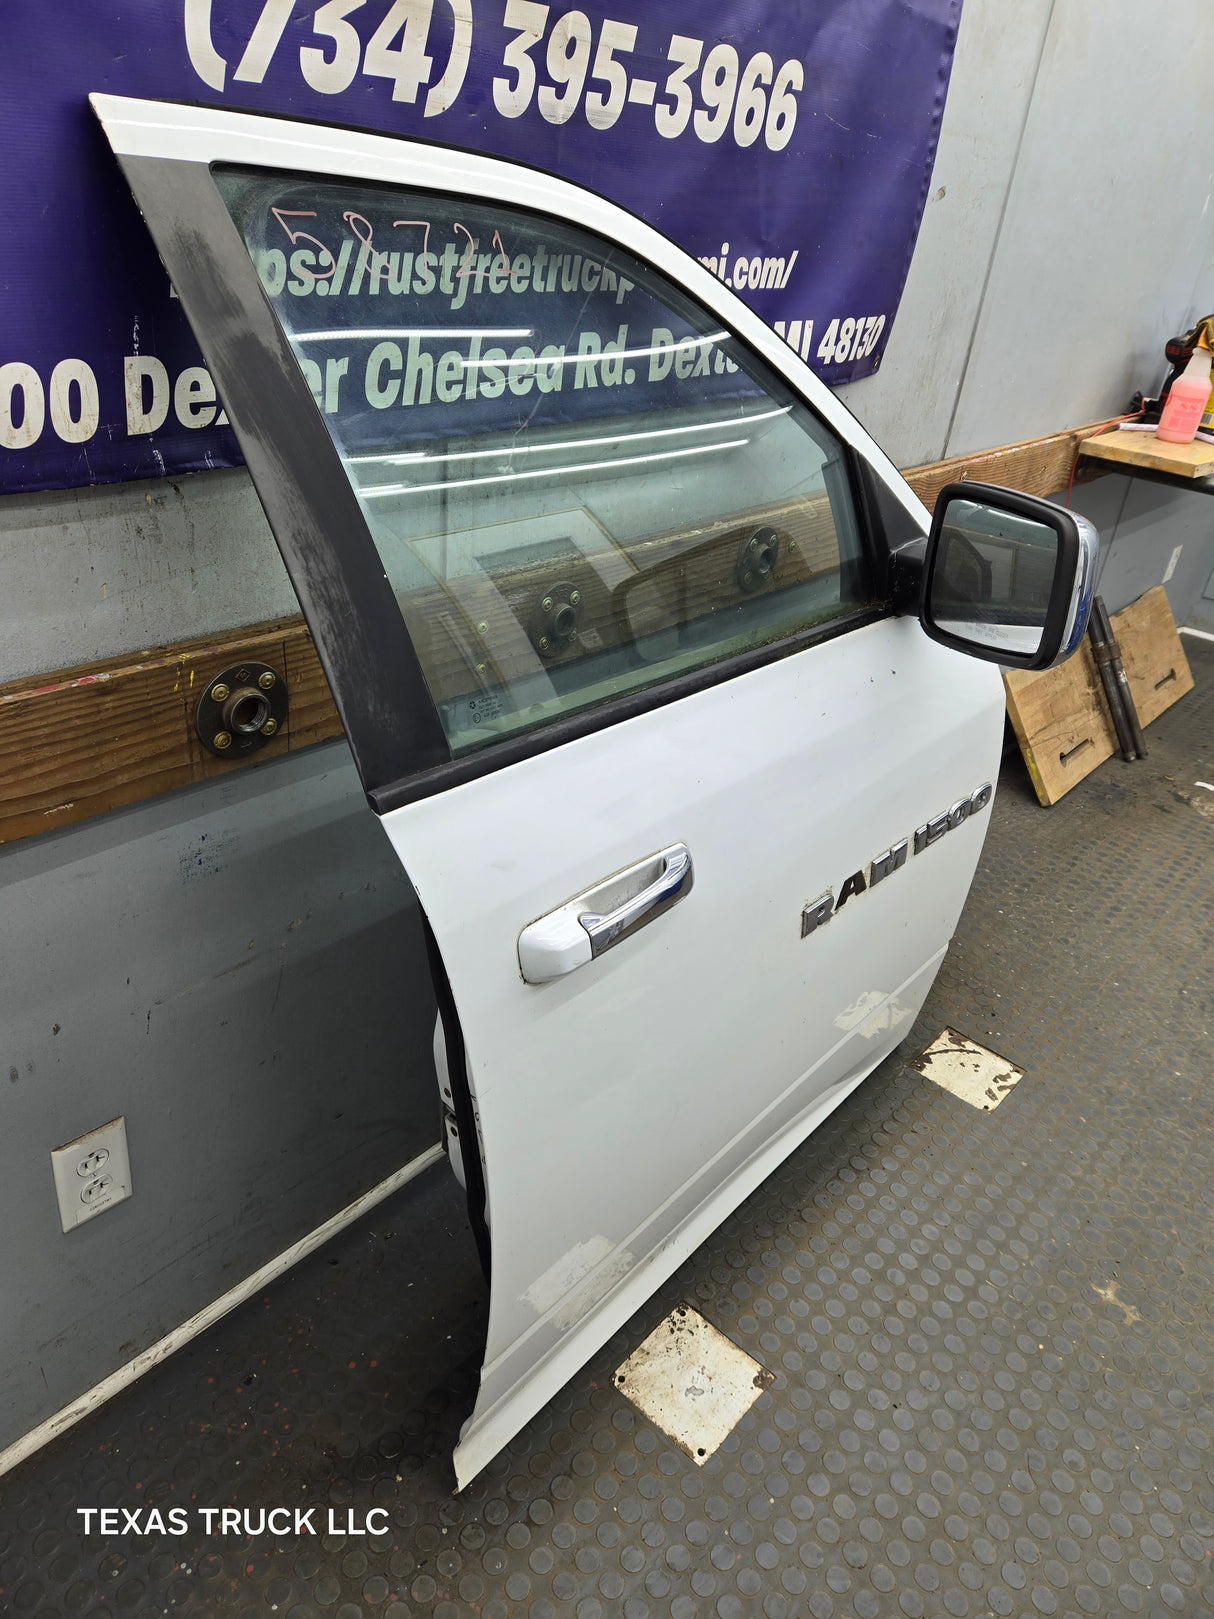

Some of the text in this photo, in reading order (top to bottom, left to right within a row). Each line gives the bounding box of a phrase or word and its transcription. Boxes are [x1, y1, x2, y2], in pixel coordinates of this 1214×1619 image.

[493, 0, 804, 151] 395-3966
[364, 334, 566, 409] Chelsea
[573, 324, 636, 389] Rd.
[816, 314, 886, 365] 48130
[801, 782, 993, 939] RAM 1500
